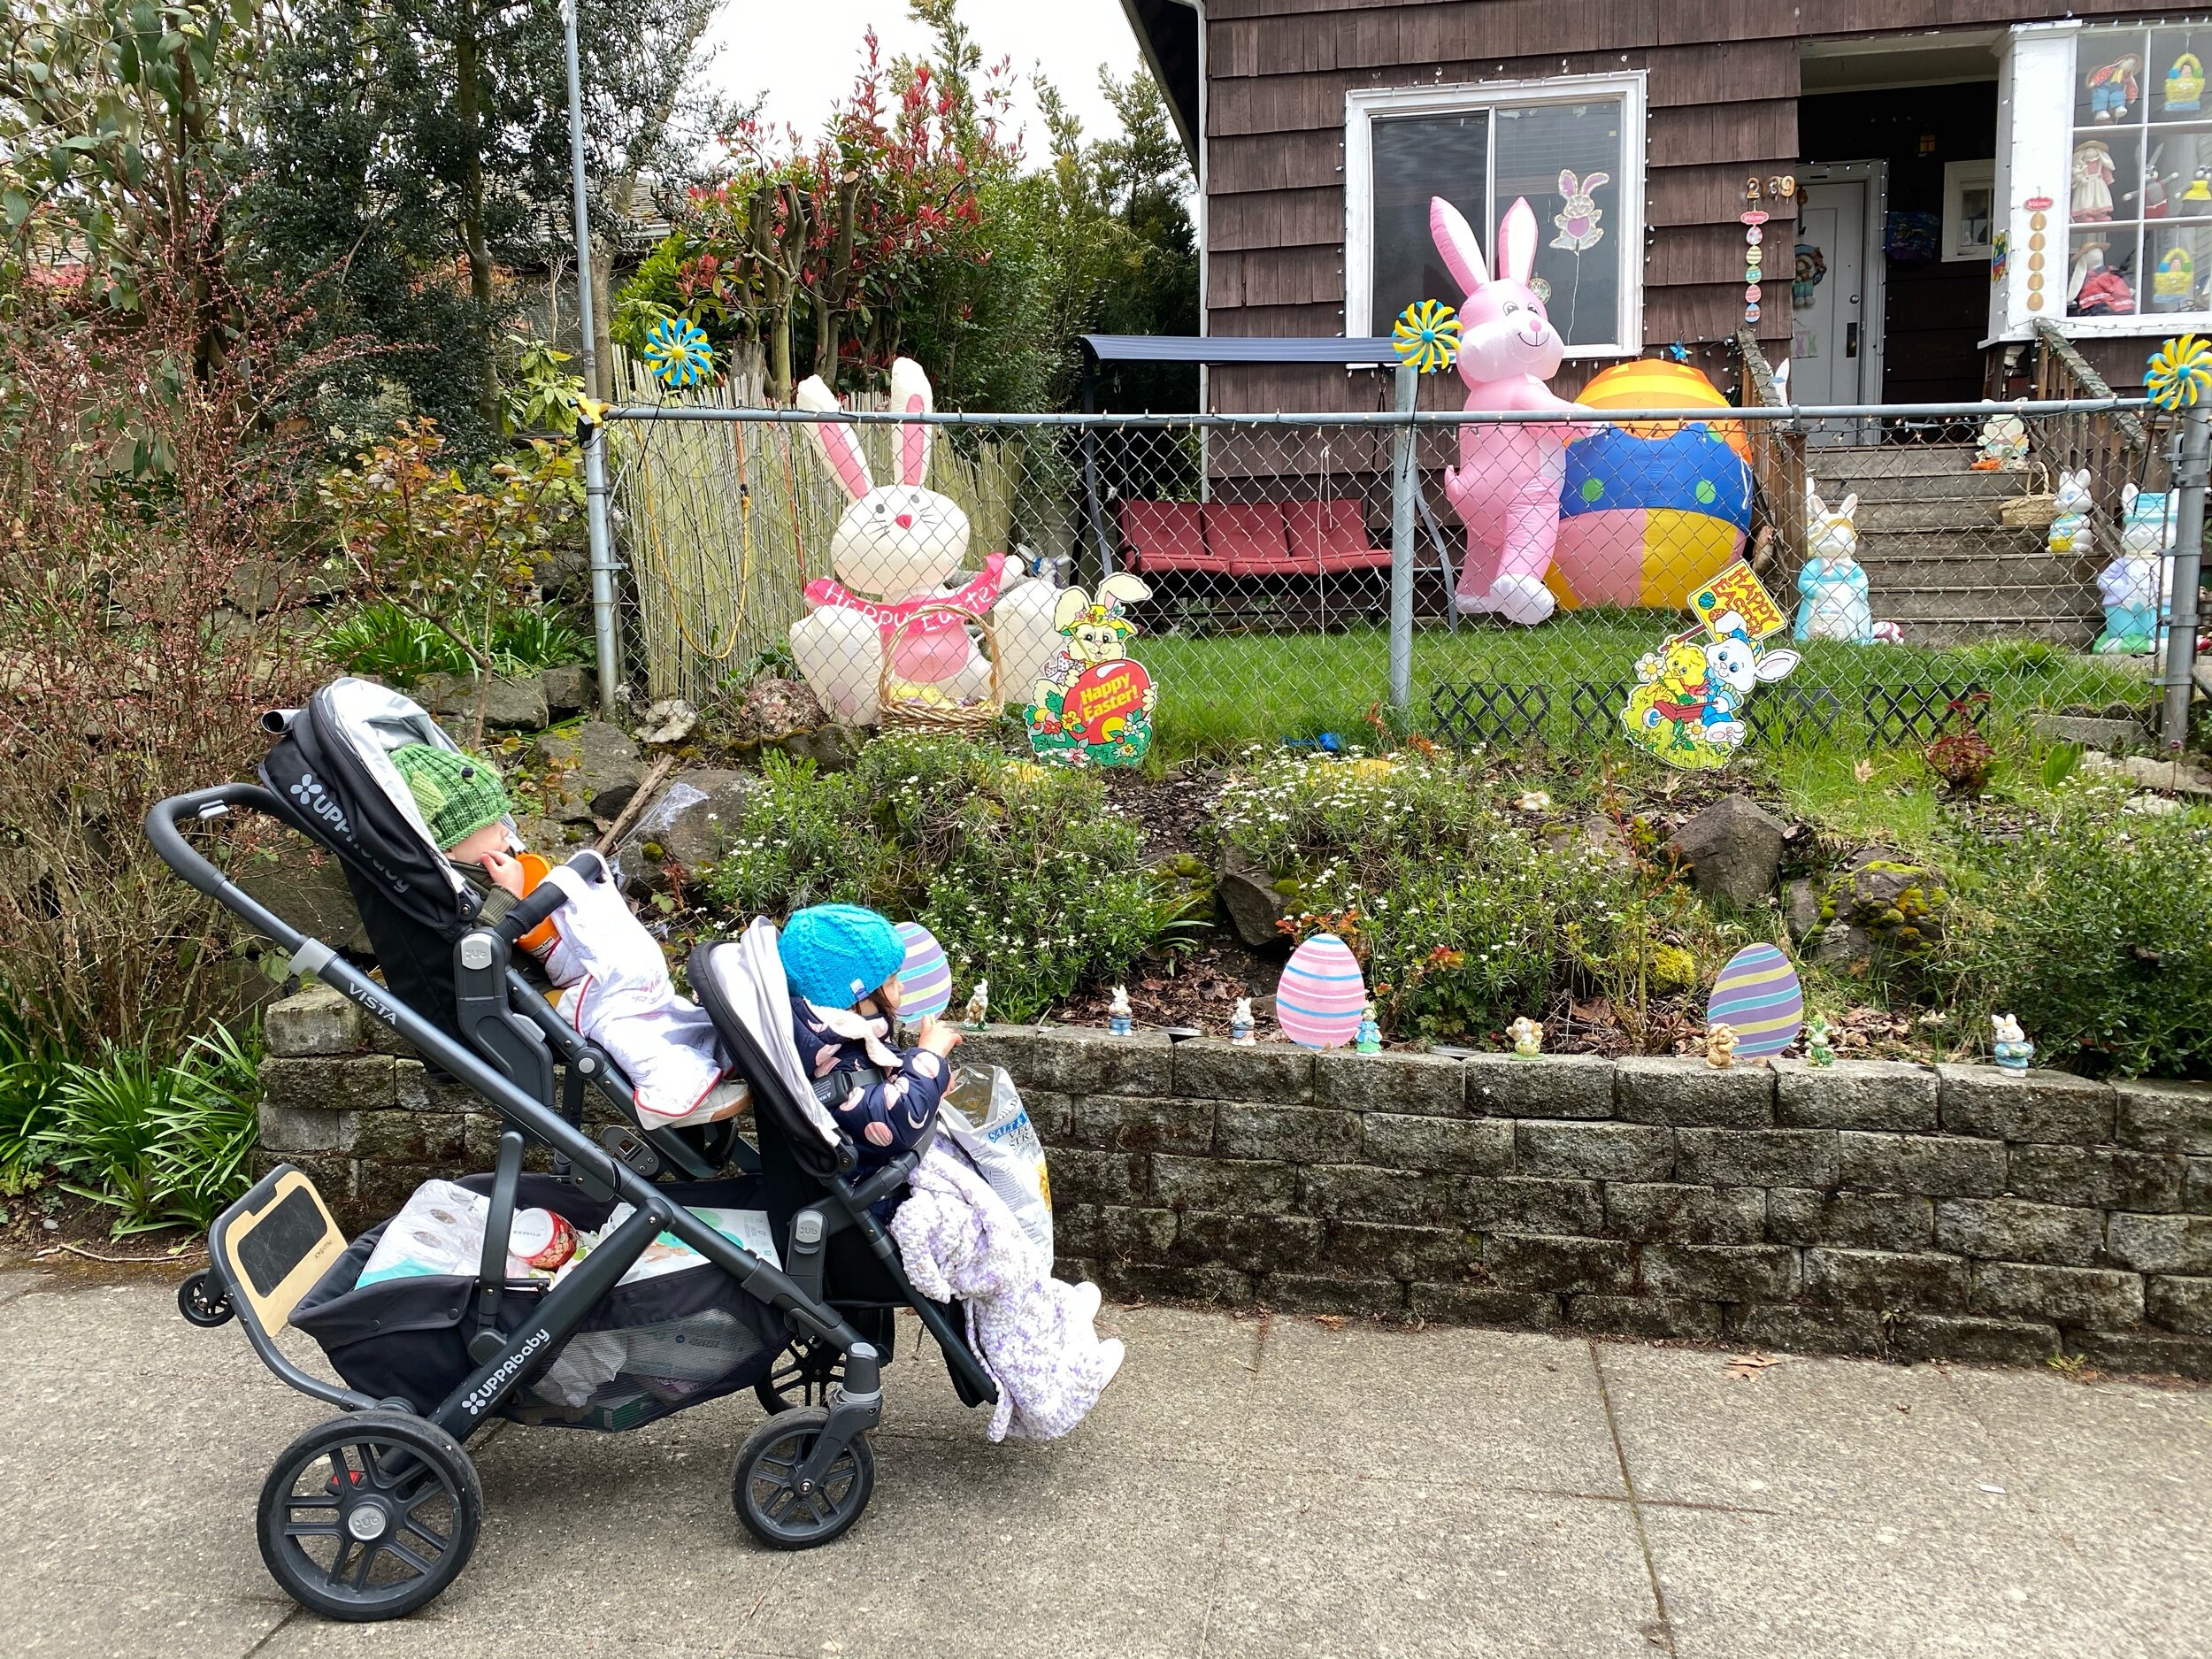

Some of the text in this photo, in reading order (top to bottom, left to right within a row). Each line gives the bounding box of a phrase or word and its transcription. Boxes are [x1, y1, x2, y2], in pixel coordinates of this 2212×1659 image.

[1711, 578, 1763, 638] EASTER
[1728, 566, 1779, 626] HAPPY
[1080, 672, 1131, 706] Happy
[1083, 685, 1139, 722] Easter!
[349, 982, 397, 1025] VISTA
[478, 1328, 551, 1398] UPPAbaby
